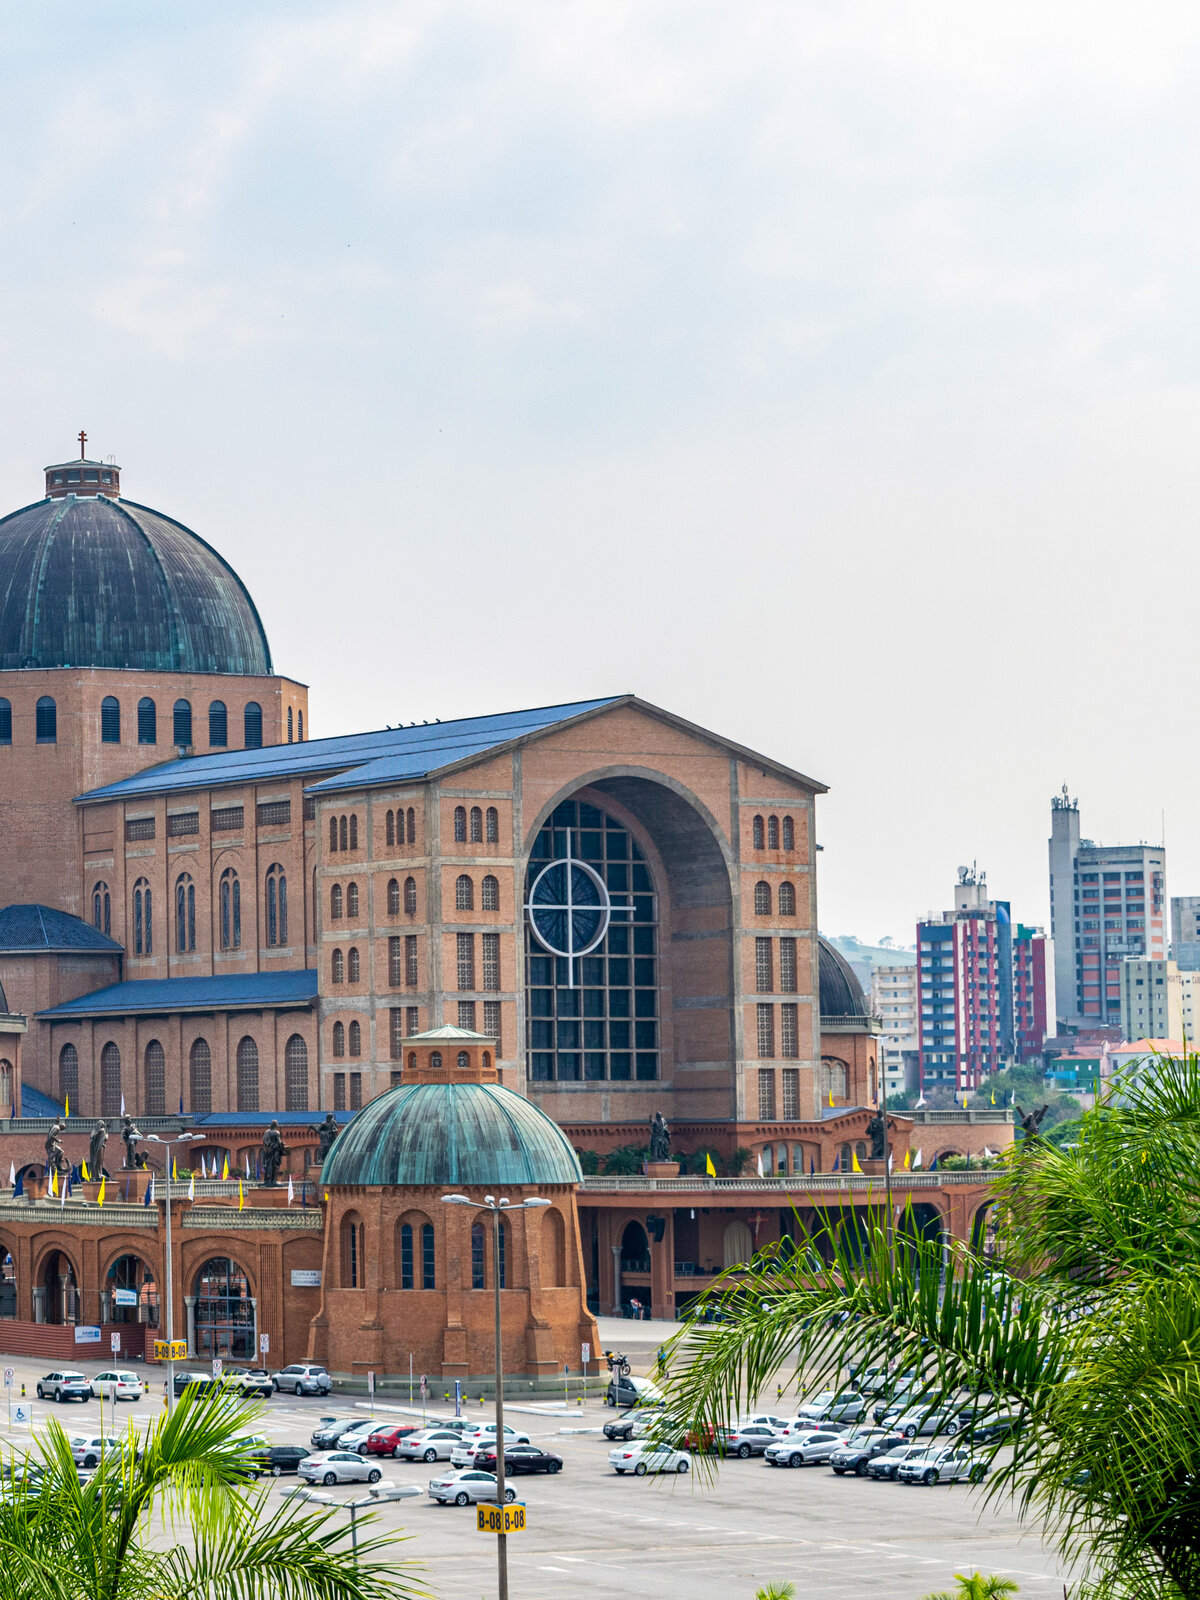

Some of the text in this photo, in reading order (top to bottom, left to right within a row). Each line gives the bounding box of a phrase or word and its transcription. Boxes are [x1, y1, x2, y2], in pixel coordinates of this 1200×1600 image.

[155, 1345, 169, 1358] B-09
[172, 1345, 186, 1358] B-09
[479, 1510, 501, 1530] B-08
[505, 1510, 524, 1530] B-08
